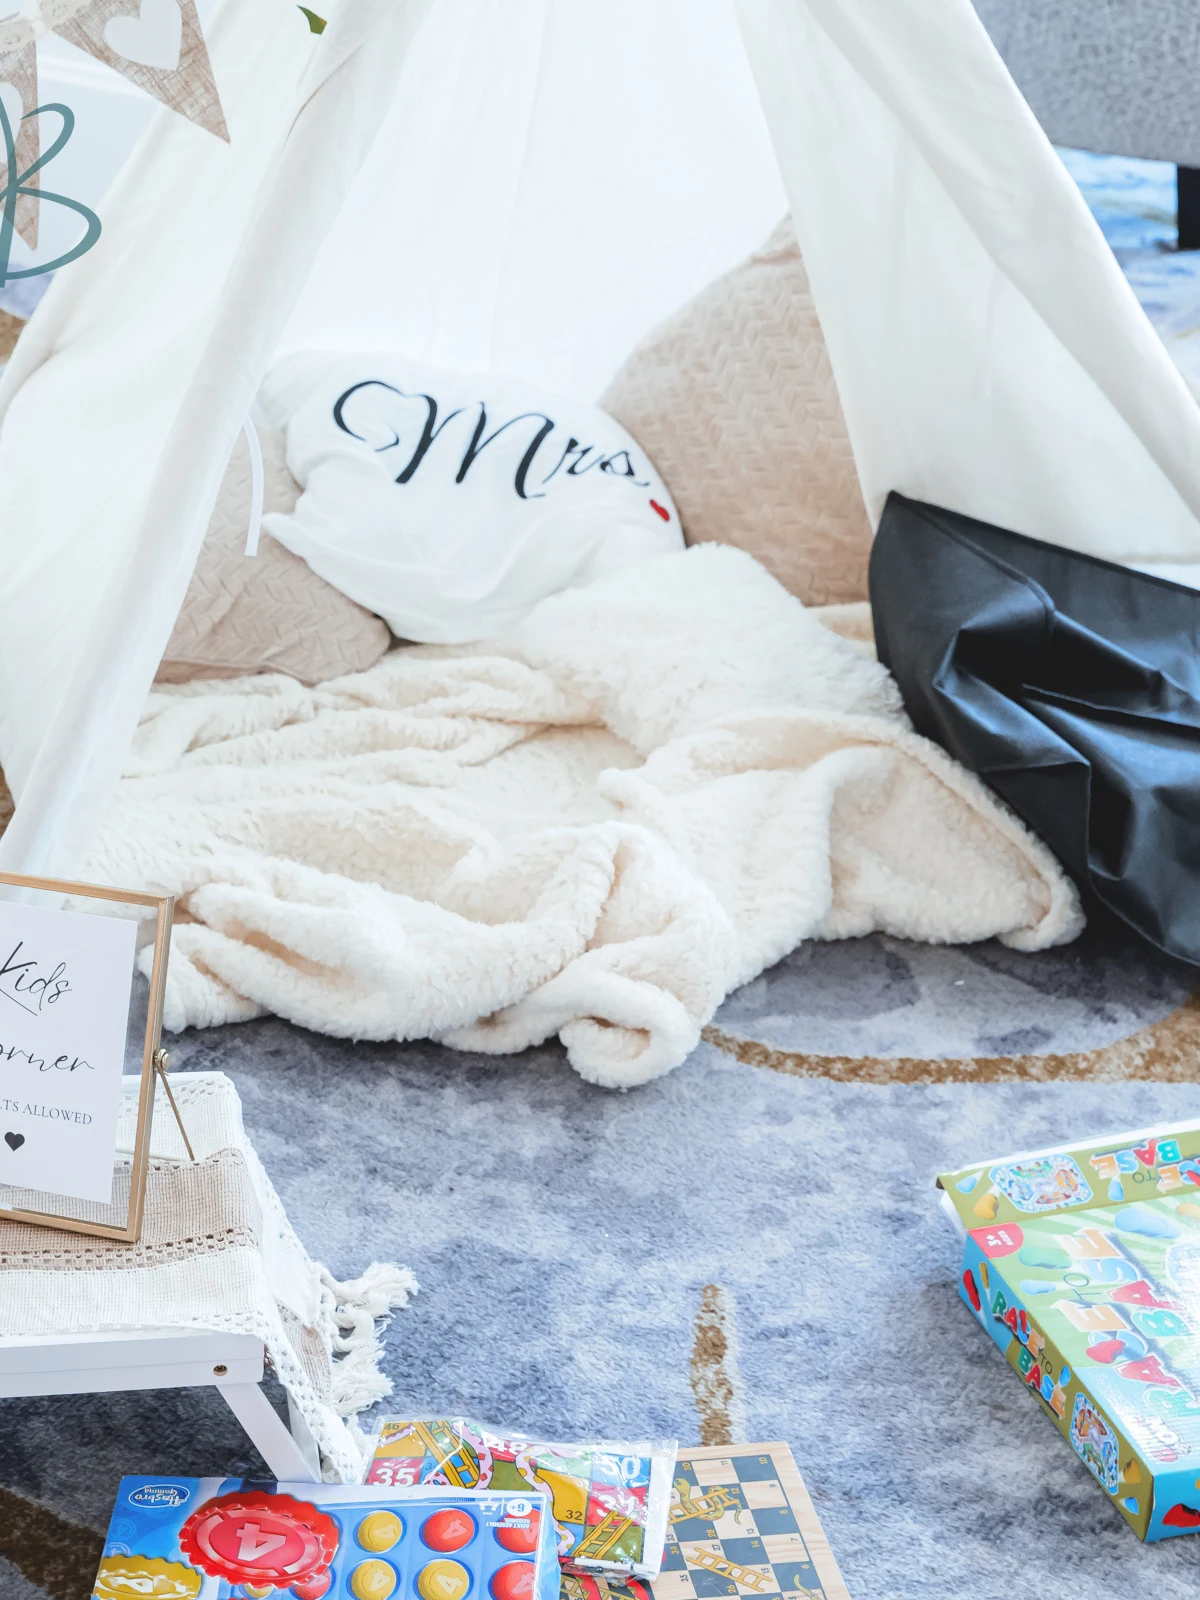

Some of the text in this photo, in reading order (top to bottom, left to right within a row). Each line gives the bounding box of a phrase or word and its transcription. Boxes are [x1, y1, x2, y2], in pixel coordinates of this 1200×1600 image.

[333, 380, 650, 499] Mrs
[22, 1102, 93, 1126] ALLOWED
[1089, 1138, 1181, 1180] BASE
[1132, 1170, 1156, 1184] TO
[1053, 1228, 1196, 1338] BASE
[1040, 1353, 1053, 1374] TO
[1017, 1345, 1067, 1420] BASE
[383, 1422, 400, 1431] 46
[487, 1438, 527, 1453] 48
[373, 1467, 416, 1486] 35
[144, 1486, 177, 1496] Gaming
[134, 1493, 187, 1506] Hasbro
[511, 1502, 525, 1513] 6+
[565, 1509, 582, 1521] 32
[706, 1529, 716, 1538] 28
[236, 1522, 286, 1561] 4
[680, 1574, 689, 1582] 35
[726, 1584, 736, 1593] 26
